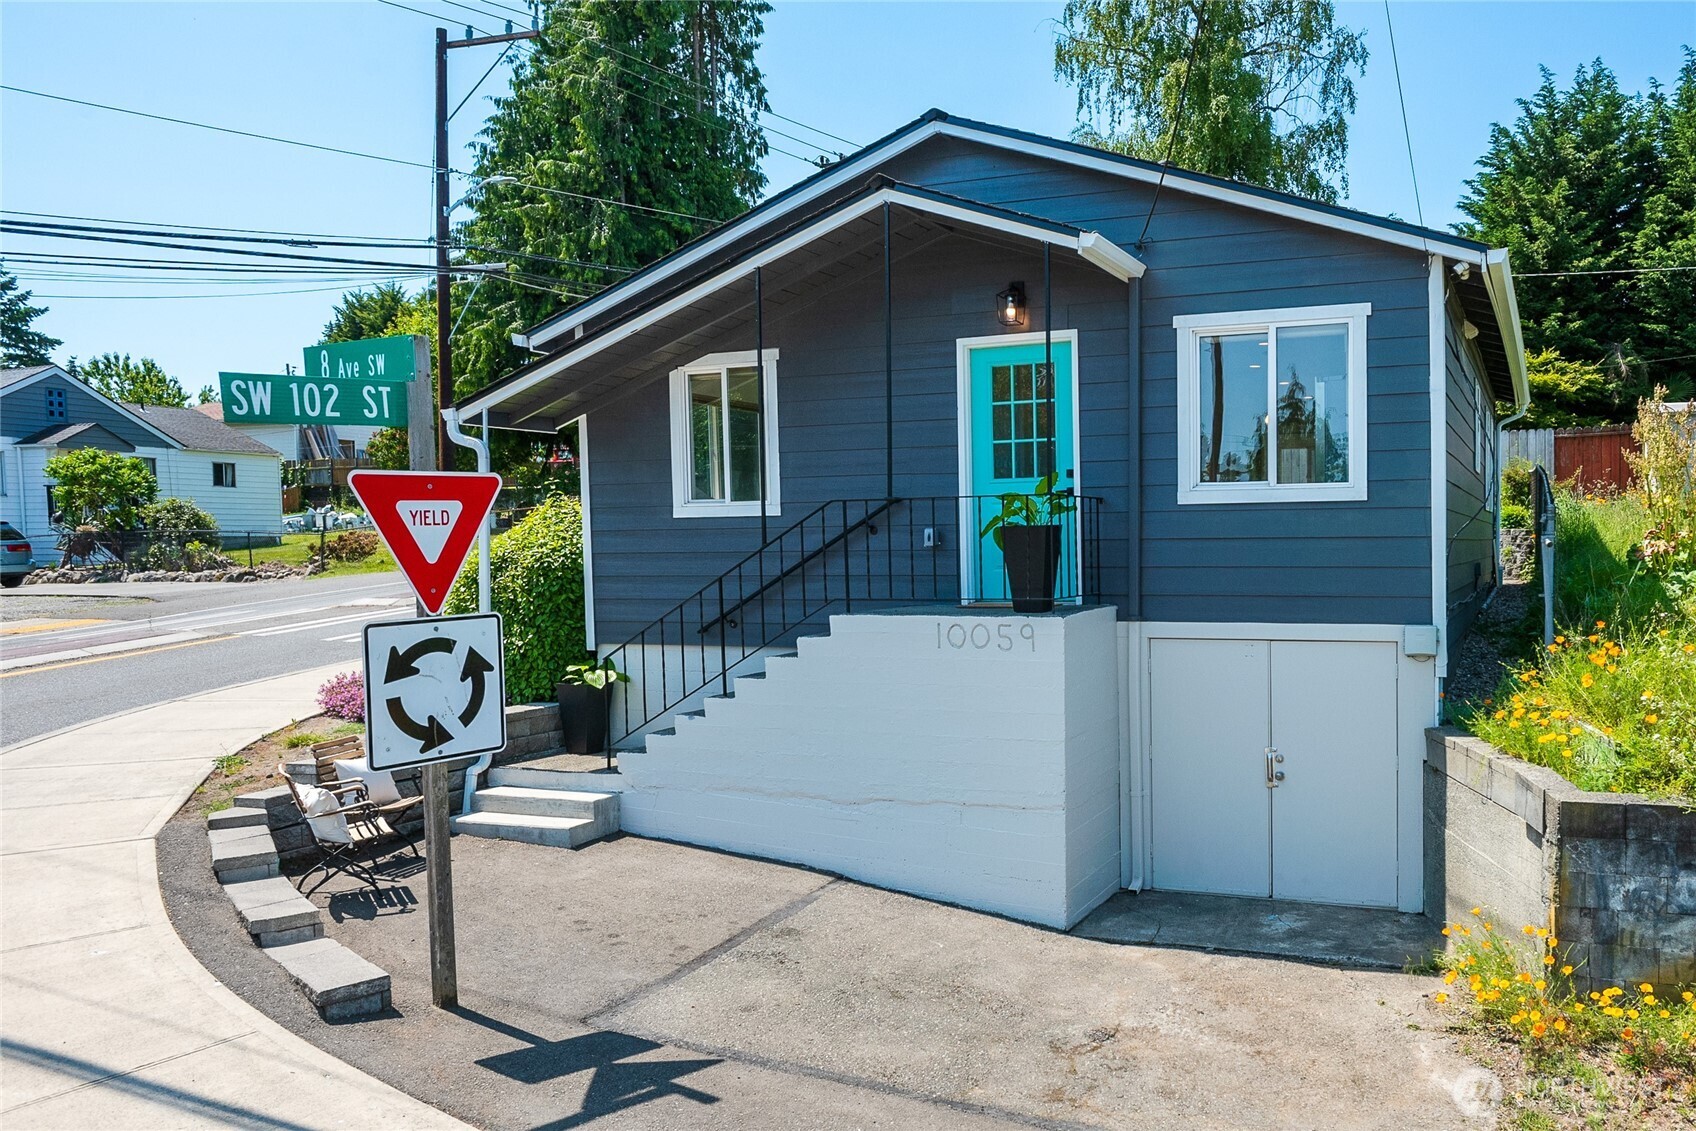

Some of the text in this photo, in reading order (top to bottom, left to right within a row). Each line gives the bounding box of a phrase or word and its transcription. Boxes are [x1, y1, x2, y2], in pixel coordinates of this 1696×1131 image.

[320, 350, 385, 378] 8 Ave SW
[230, 380, 391, 419] SW 102 ST
[409, 509, 450, 526] YIELD
[937, 622, 1035, 652] 10059
